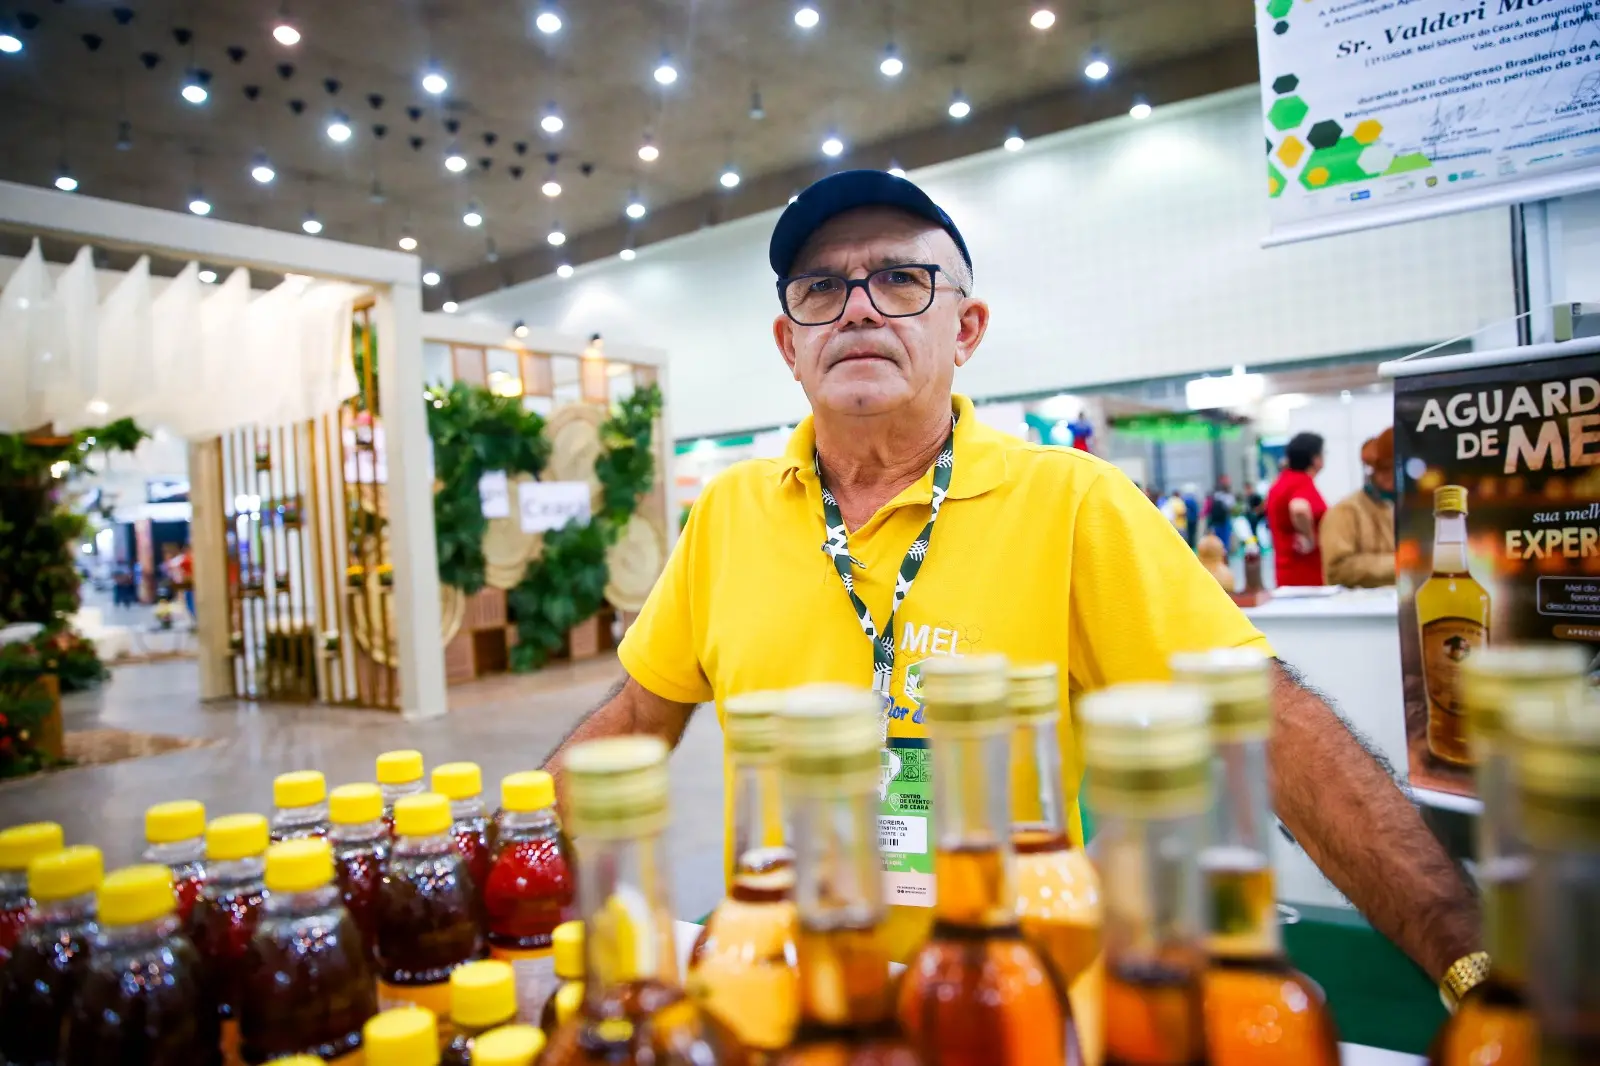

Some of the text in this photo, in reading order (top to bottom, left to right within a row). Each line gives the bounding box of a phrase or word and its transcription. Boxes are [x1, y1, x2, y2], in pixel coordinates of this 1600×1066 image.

[1336, 40, 1372, 59] Sr.
[1384, 1, 1486, 44] Valderi
[1498, 35, 1512, 46] da
[1525, 16, 1540, 25] do
[1411, 79, 1437, 92] XXIII
[1438, 64, 1503, 85] Congresso
[1505, 48, 1567, 70] Brasileiro
[1568, 43, 1587, 55] de
[1428, 81, 1484, 99] realizado
[1485, 77, 1502, 87] no
[1555, 60, 1572, 71] de
[1574, 54, 1592, 66] 24
[1415, 376, 1600, 433] AGUARD
[1456, 413, 1600, 475] DE ME
[1532, 511, 1560, 523] sua
[1583, 584, 1597, 592] do
[901, 621, 965, 660] MEL
